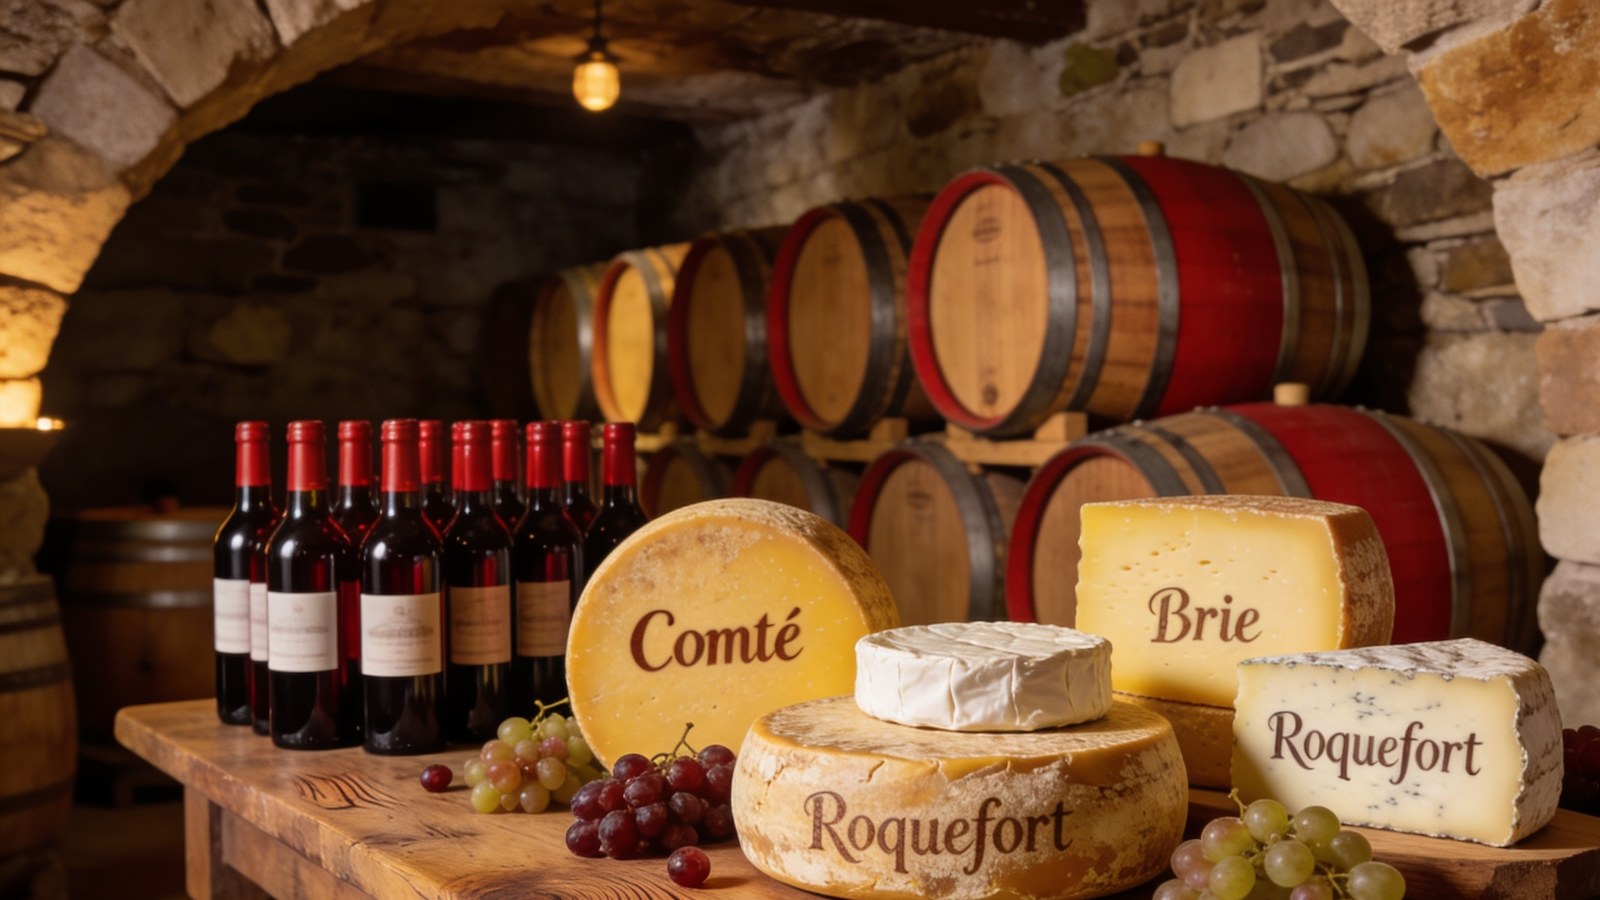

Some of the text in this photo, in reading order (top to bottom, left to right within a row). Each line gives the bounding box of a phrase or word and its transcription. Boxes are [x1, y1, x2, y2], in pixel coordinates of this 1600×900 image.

[629, 606, 804, 673] Comté
[1148, 586, 1263, 644] Brie
[1267, 709, 1484, 785] Roquefort
[803, 790, 1075, 876] Roquefort
